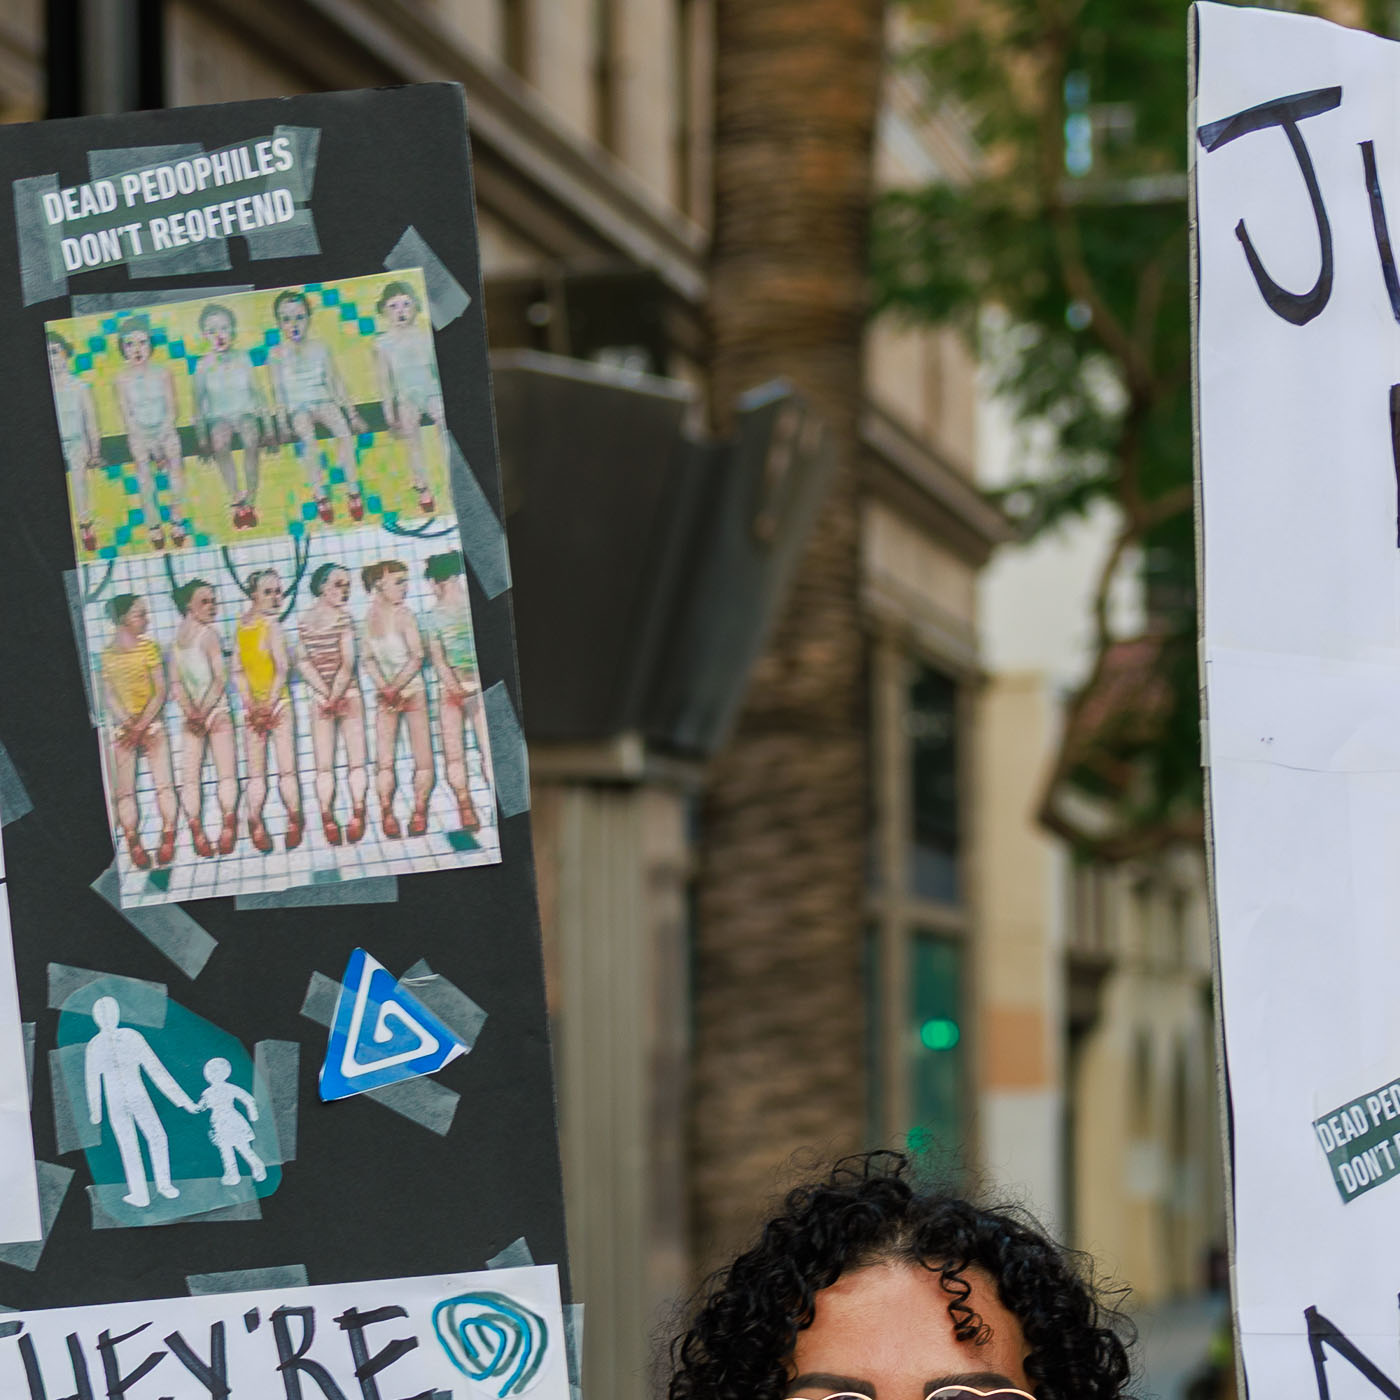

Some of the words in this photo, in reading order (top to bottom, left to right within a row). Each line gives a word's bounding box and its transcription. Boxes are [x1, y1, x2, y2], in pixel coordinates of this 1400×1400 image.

[43, 180, 118, 226] DEAD
[121, 137, 295, 208] PEDOPHILES
[60, 222, 143, 272] DON'T
[148, 188, 296, 251] REOFFEND
[1316, 1104, 1369, 1154] DEAD
[1338, 1139, 1396, 1194] DON'T
